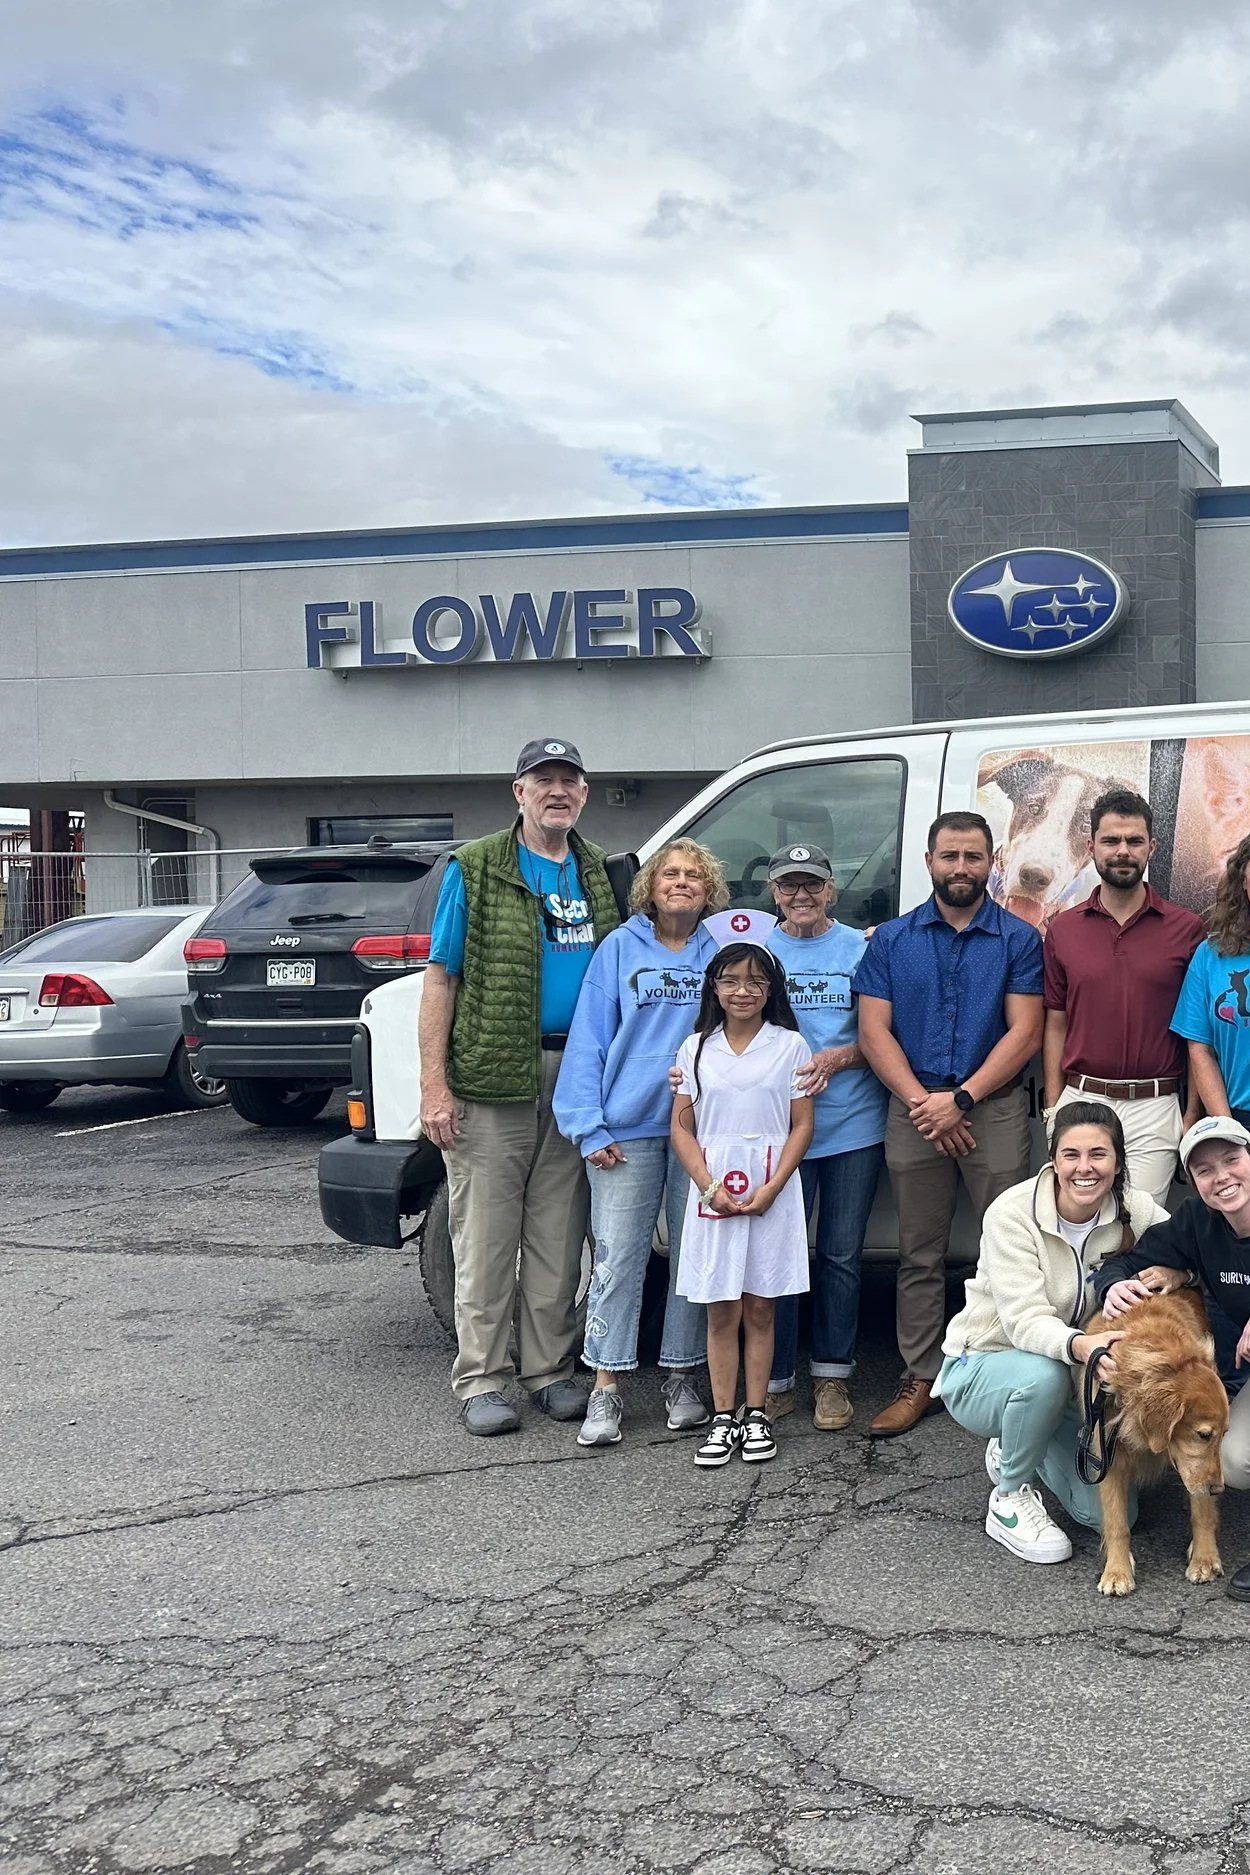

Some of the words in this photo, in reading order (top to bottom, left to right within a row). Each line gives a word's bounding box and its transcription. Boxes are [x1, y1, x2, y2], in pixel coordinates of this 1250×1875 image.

[304, 587, 703, 668] FLOWER
[549, 894, 589, 918] Seco
[556, 918, 594, 944] Chan
[270, 935, 301, 947] Jeep
[645, 988, 701, 1000] VOLUNTE
[788, 994, 845, 1004] LUNTEER
[1220, 1271, 1243, 1284] SURLY
